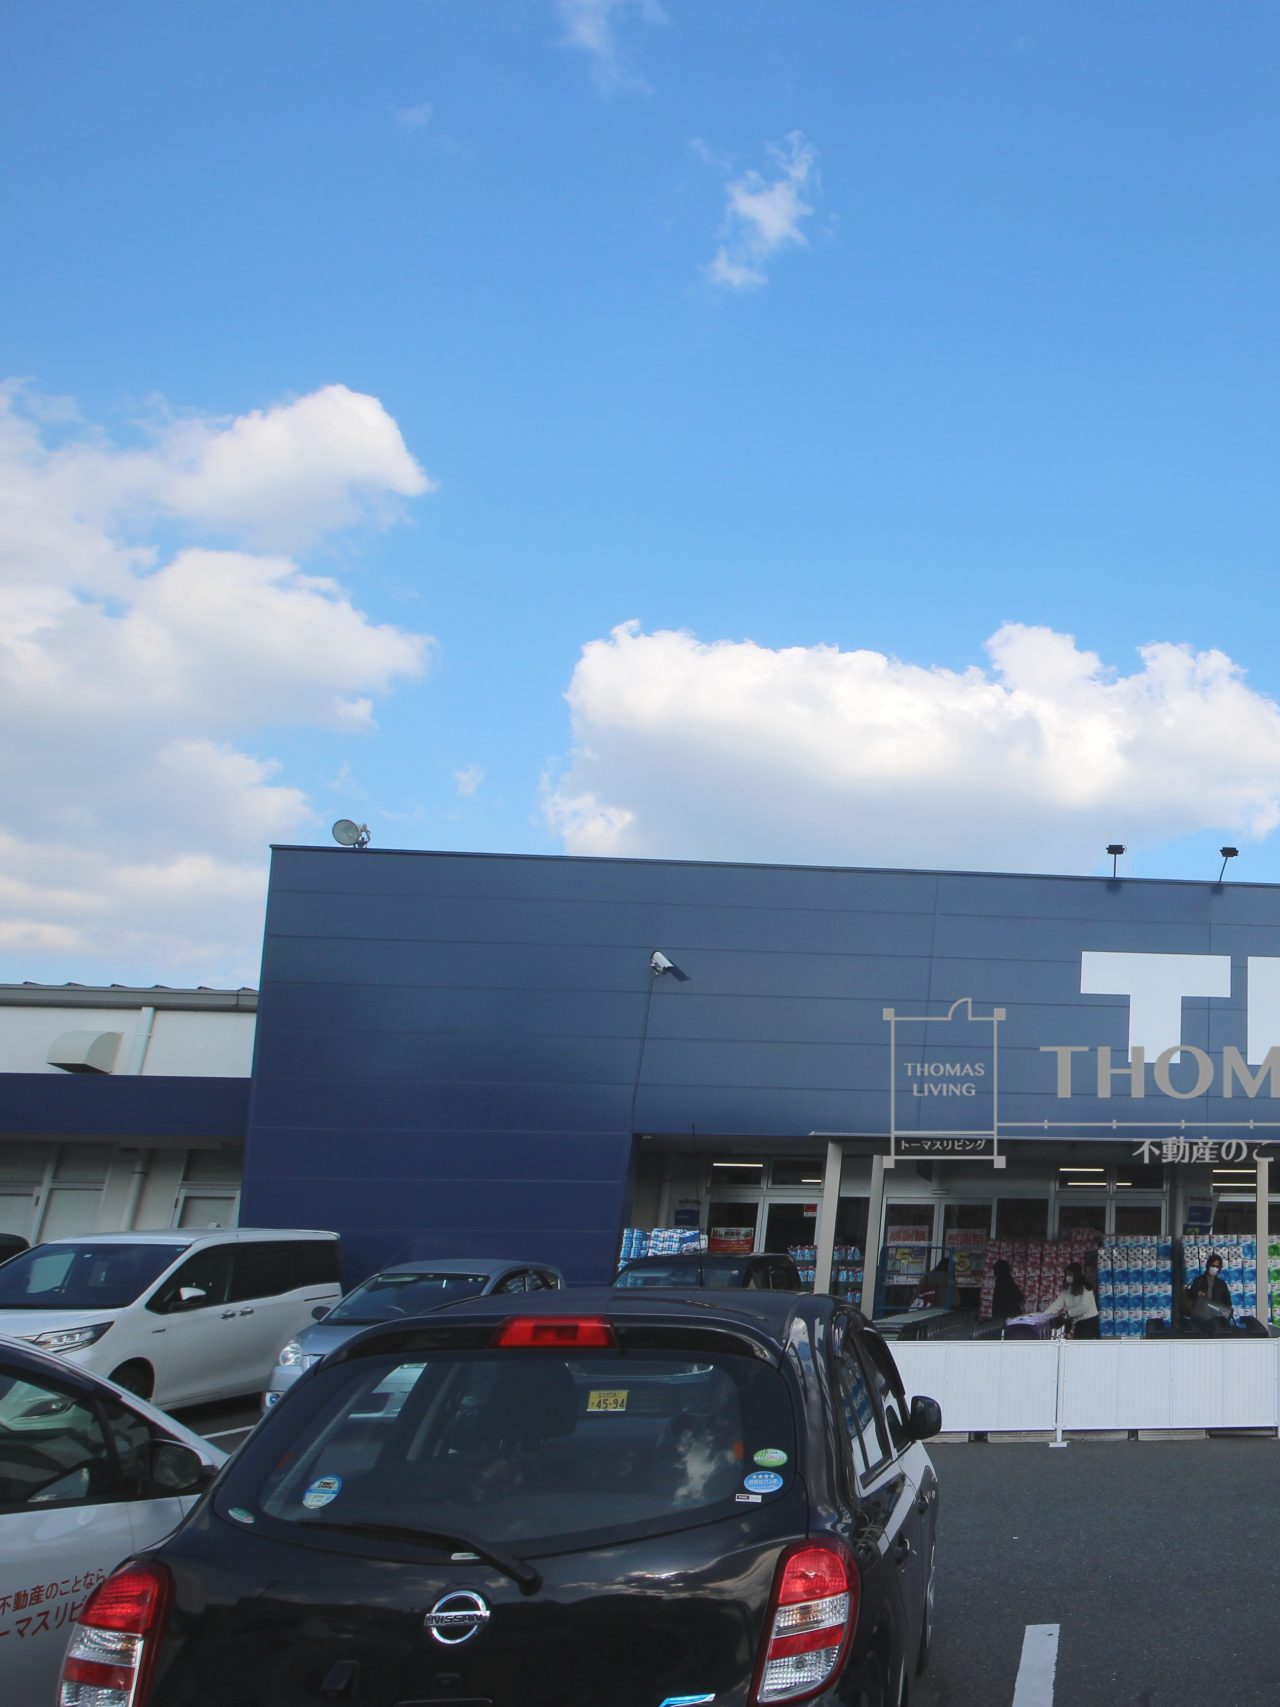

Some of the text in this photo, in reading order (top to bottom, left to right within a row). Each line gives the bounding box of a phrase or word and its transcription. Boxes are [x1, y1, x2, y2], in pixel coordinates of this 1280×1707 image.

[0, 1568, 106, 1616] 不動産のことなら
[429, 1613, 480, 1626] NISSAN
